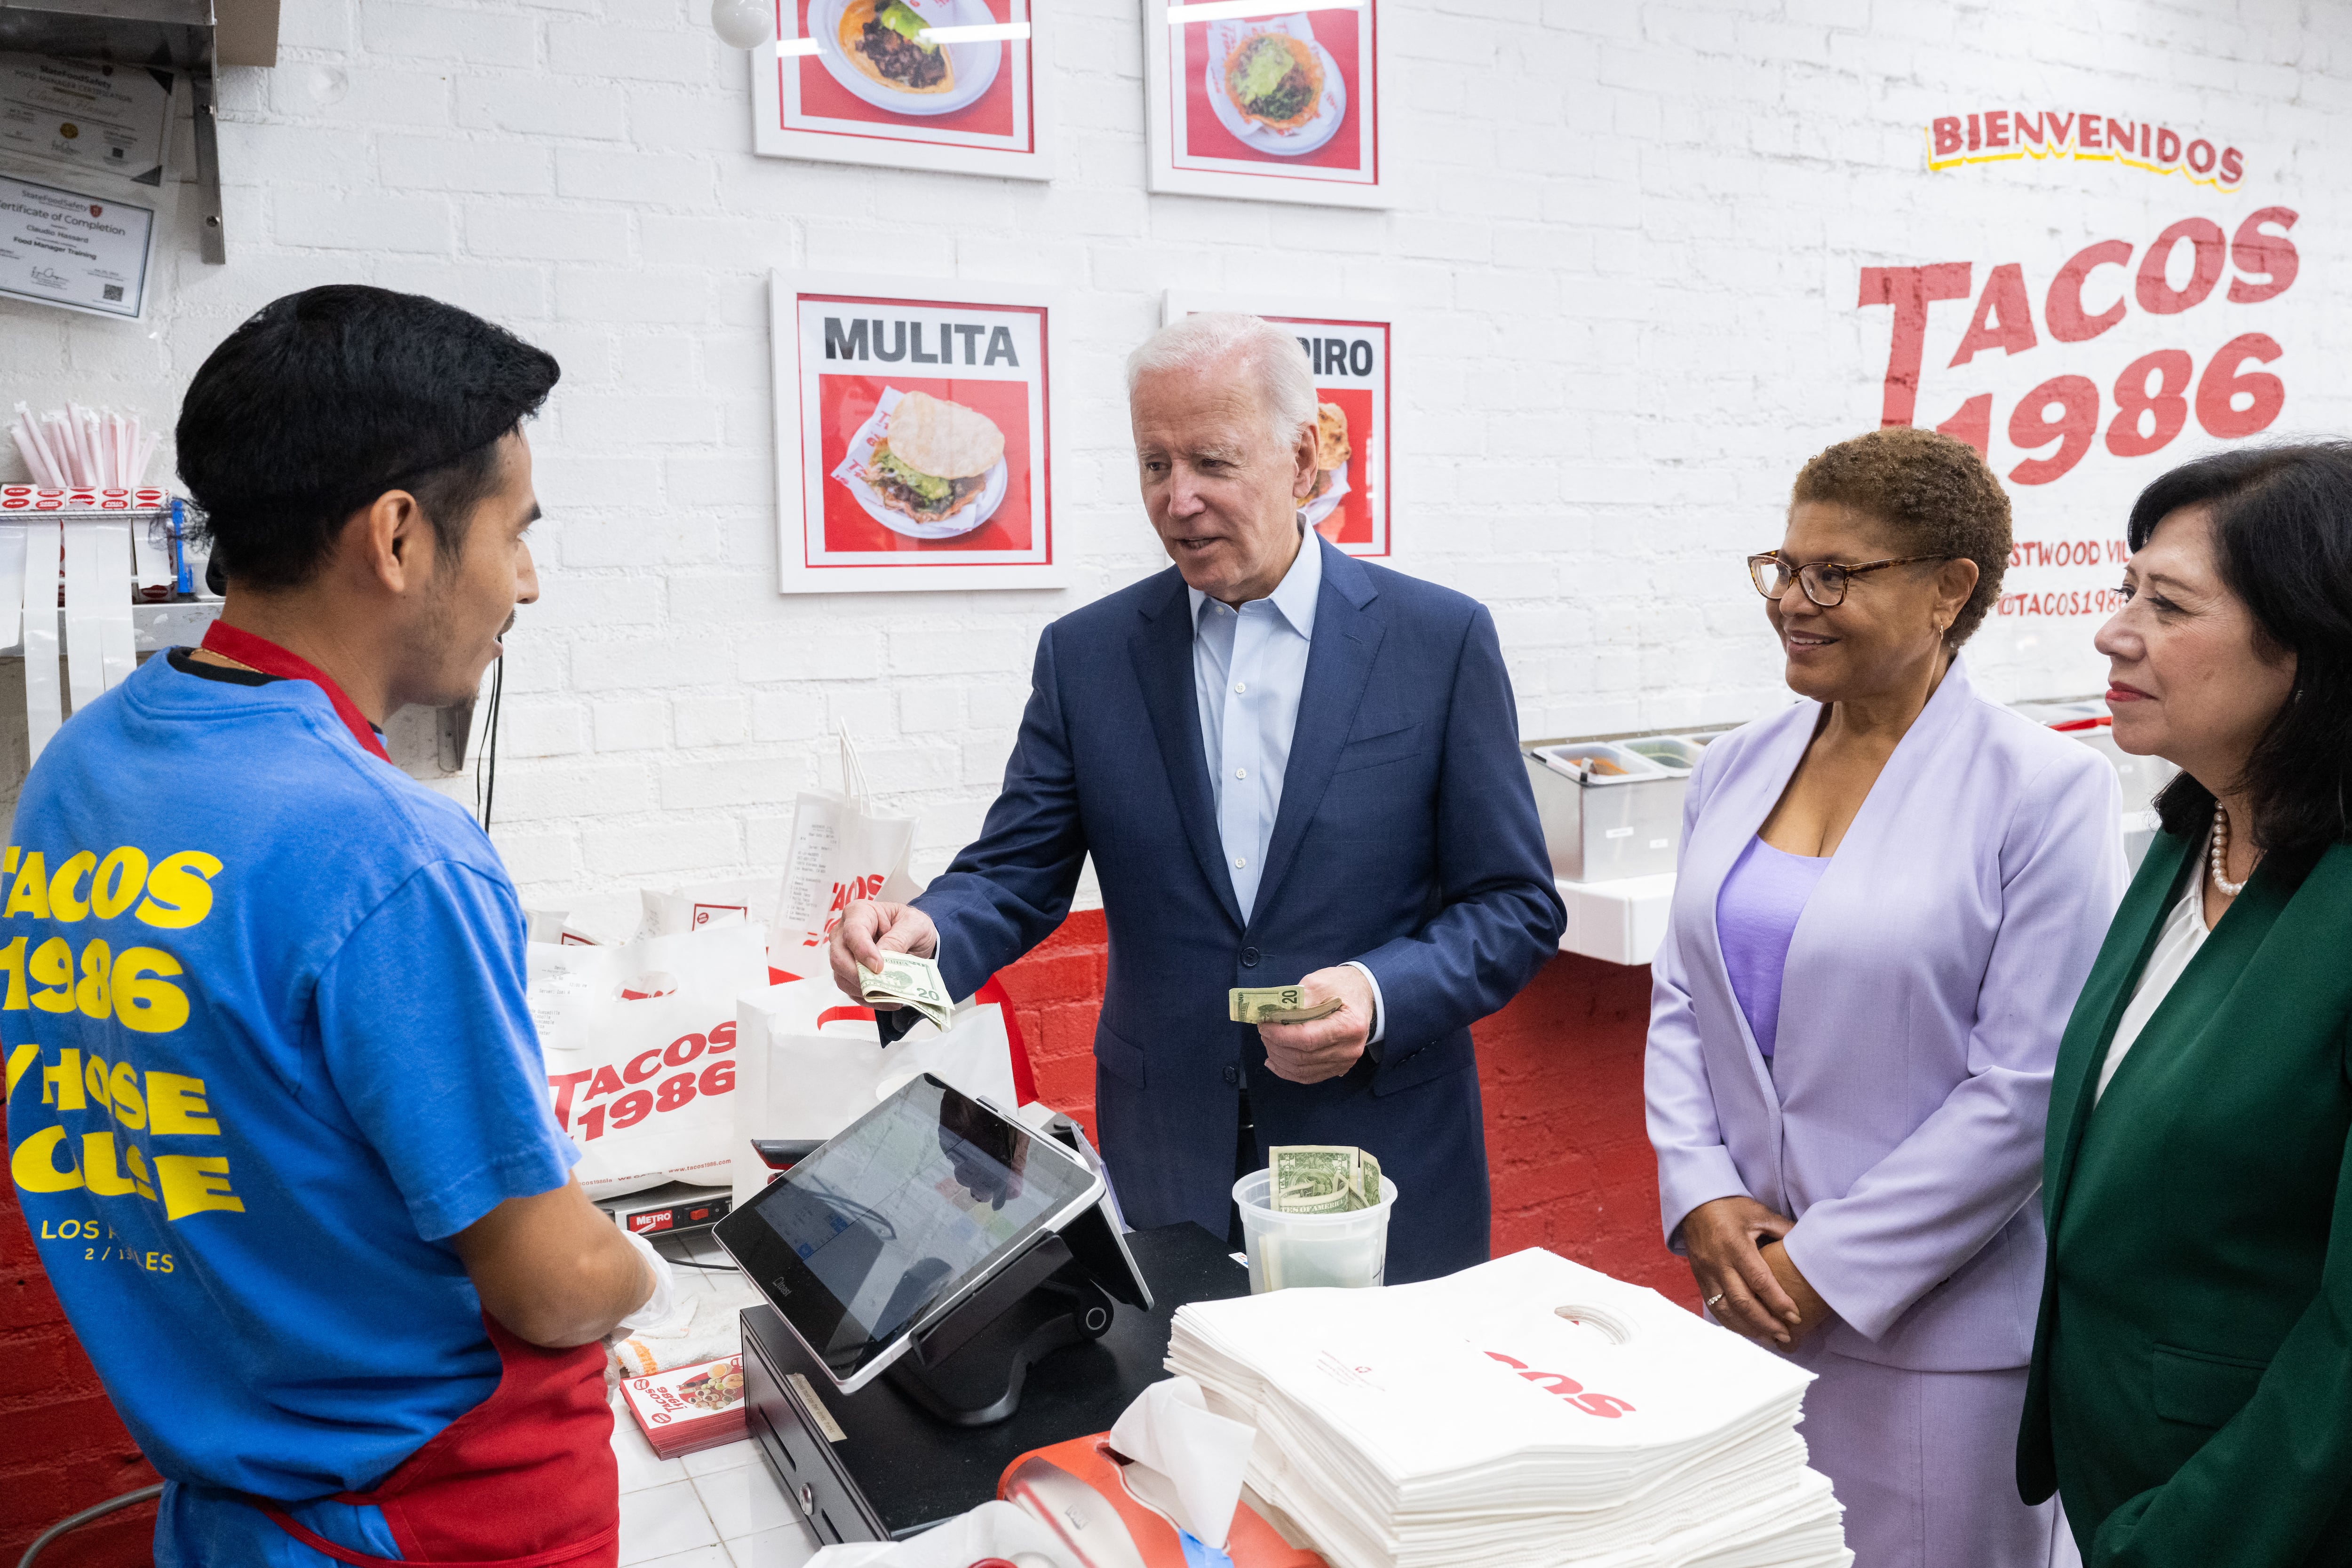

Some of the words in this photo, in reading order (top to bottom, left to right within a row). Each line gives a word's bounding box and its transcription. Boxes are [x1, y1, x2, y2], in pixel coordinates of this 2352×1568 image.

[1932, 110, 2245, 185] BIENVENIDOS
[0, 200, 49, 219] ertificate
[51, 213, 63, 222] of
[64, 215, 127, 238] Completion
[1858, 206, 2300, 427] TACOS
[825, 317, 1020, 368] MULITA
[1936, 332, 2285, 485] 1986
[2009, 541, 2099, 567] STWOOD
[0, 936, 190, 1033] 1986
[916, 988, 940, 1001] 20
[1282, 990, 1297, 1004] 20
[548, 1021, 737, 1133] TACOS
[577, 1060, 736, 1142] 1986
[668, 1159, 731, 1173] www.tacos1986.com
[41, 1220, 99, 1239] LOS
[636, 1212, 671, 1226] METRO
[777, 1281, 793, 1297] toast
[645, 1388, 672, 1413] TACOS
[657, 1386, 684, 1410] 1986
